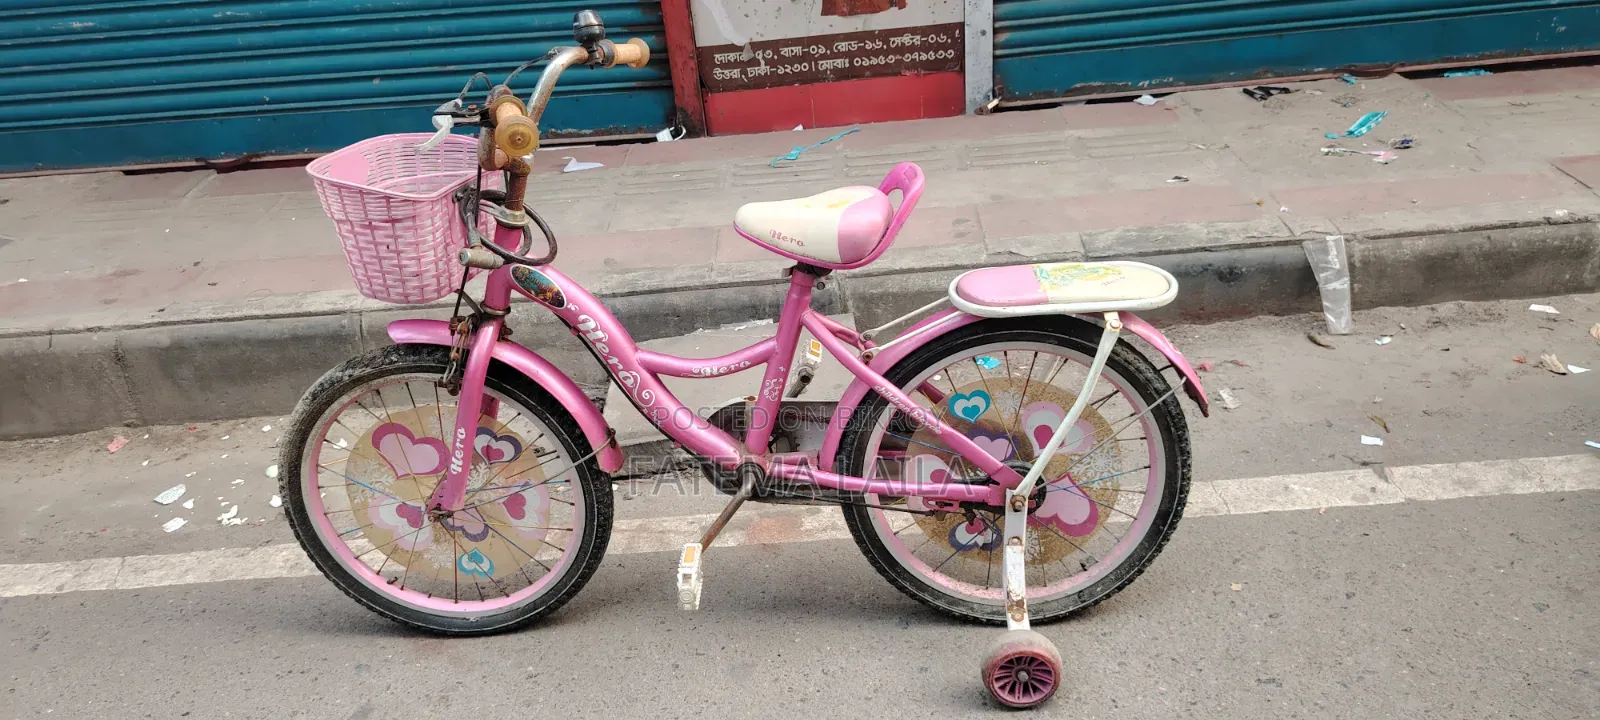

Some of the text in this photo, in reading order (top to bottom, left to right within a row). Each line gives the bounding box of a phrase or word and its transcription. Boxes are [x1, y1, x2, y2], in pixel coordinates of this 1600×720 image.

[768, 228, 805, 247] Hero
[576, 314, 642, 391] Hero
[692, 359, 752, 378] Hero
[450, 426, 467, 475] Hero
